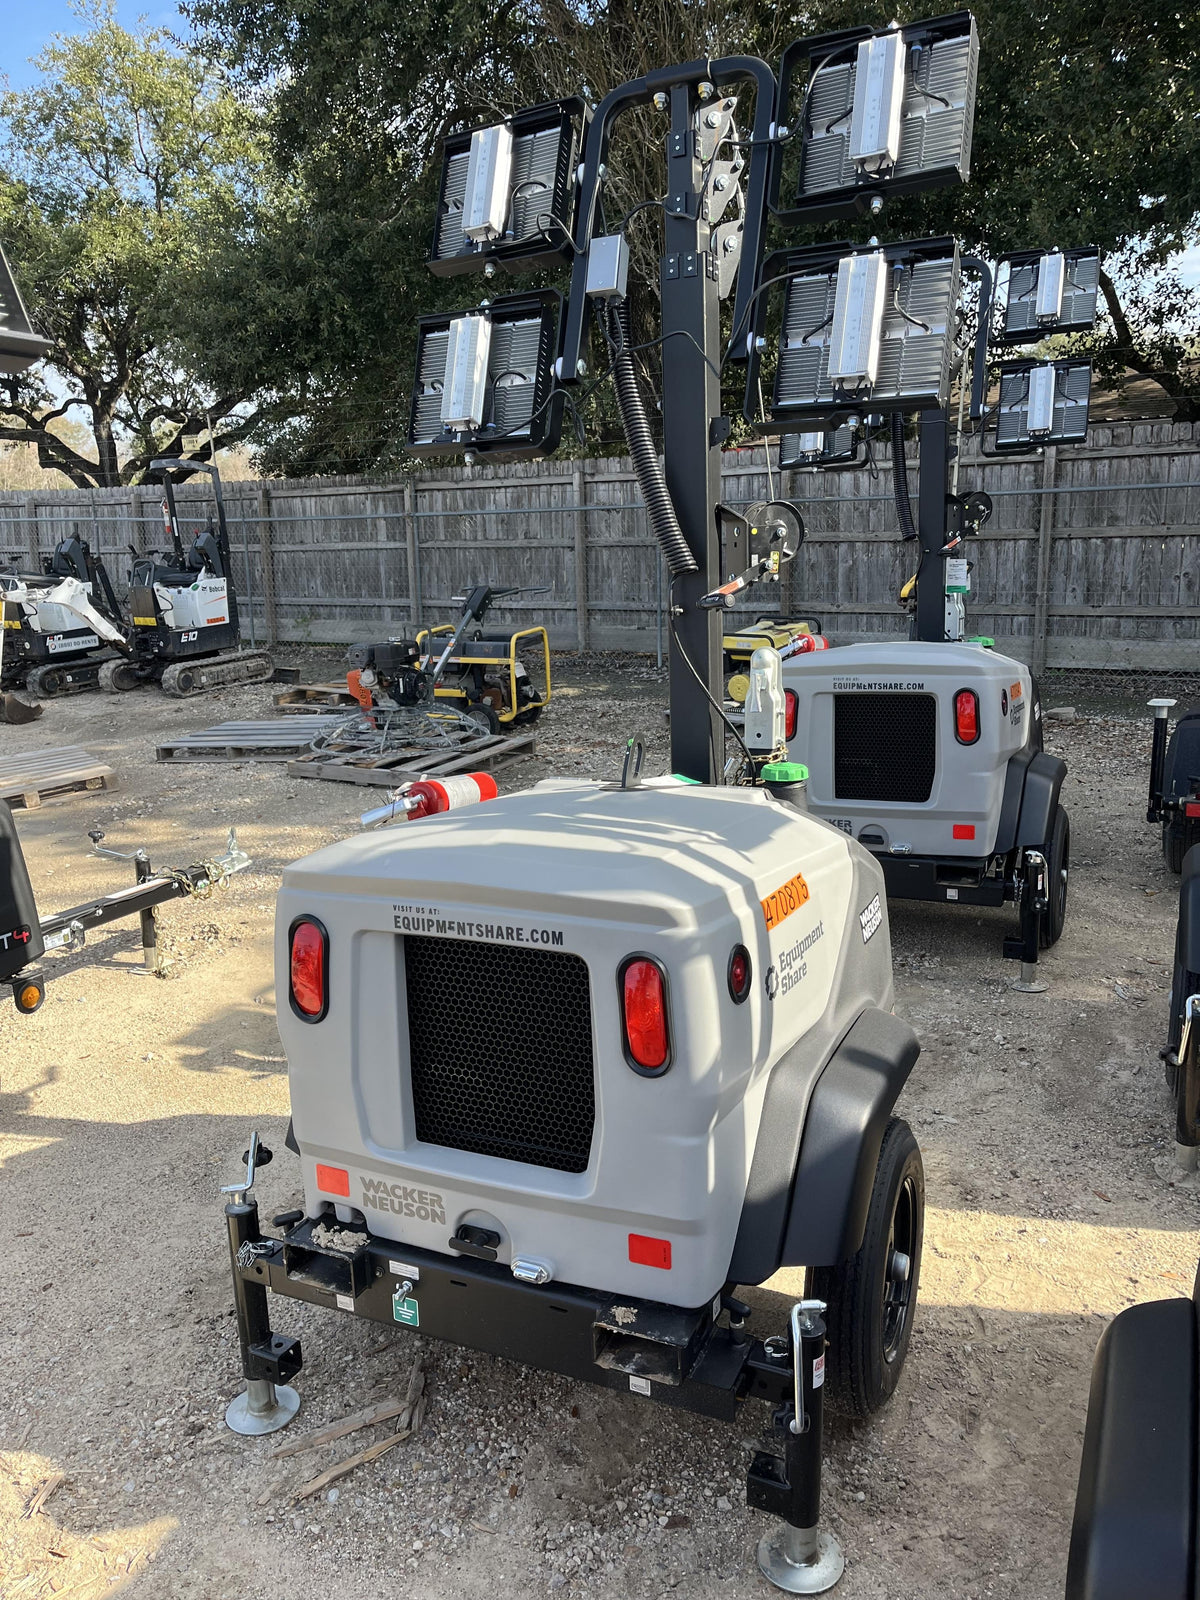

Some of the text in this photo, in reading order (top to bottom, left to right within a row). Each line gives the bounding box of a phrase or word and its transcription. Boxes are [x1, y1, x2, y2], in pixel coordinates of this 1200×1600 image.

[208, 585, 225, 593] Bobcat
[181, 631, 198, 643] E10
[833, 682, 924, 690] EQUIPMENTSHARE.COM
[392, 904, 440, 916] VISIT US AT:
[766, 875, 809, 926] 470815
[860, 894, 880, 928] WACKER
[394, 915, 564, 946] EQUIPMENTSHARE.COM
[862, 907, 882, 942] NEUSON
[779, 920, 824, 972] Equipment
[780, 962, 807, 996] Share
[360, 1176, 445, 1210] WACKER
[363, 1192, 446, 1225] NEUSON
